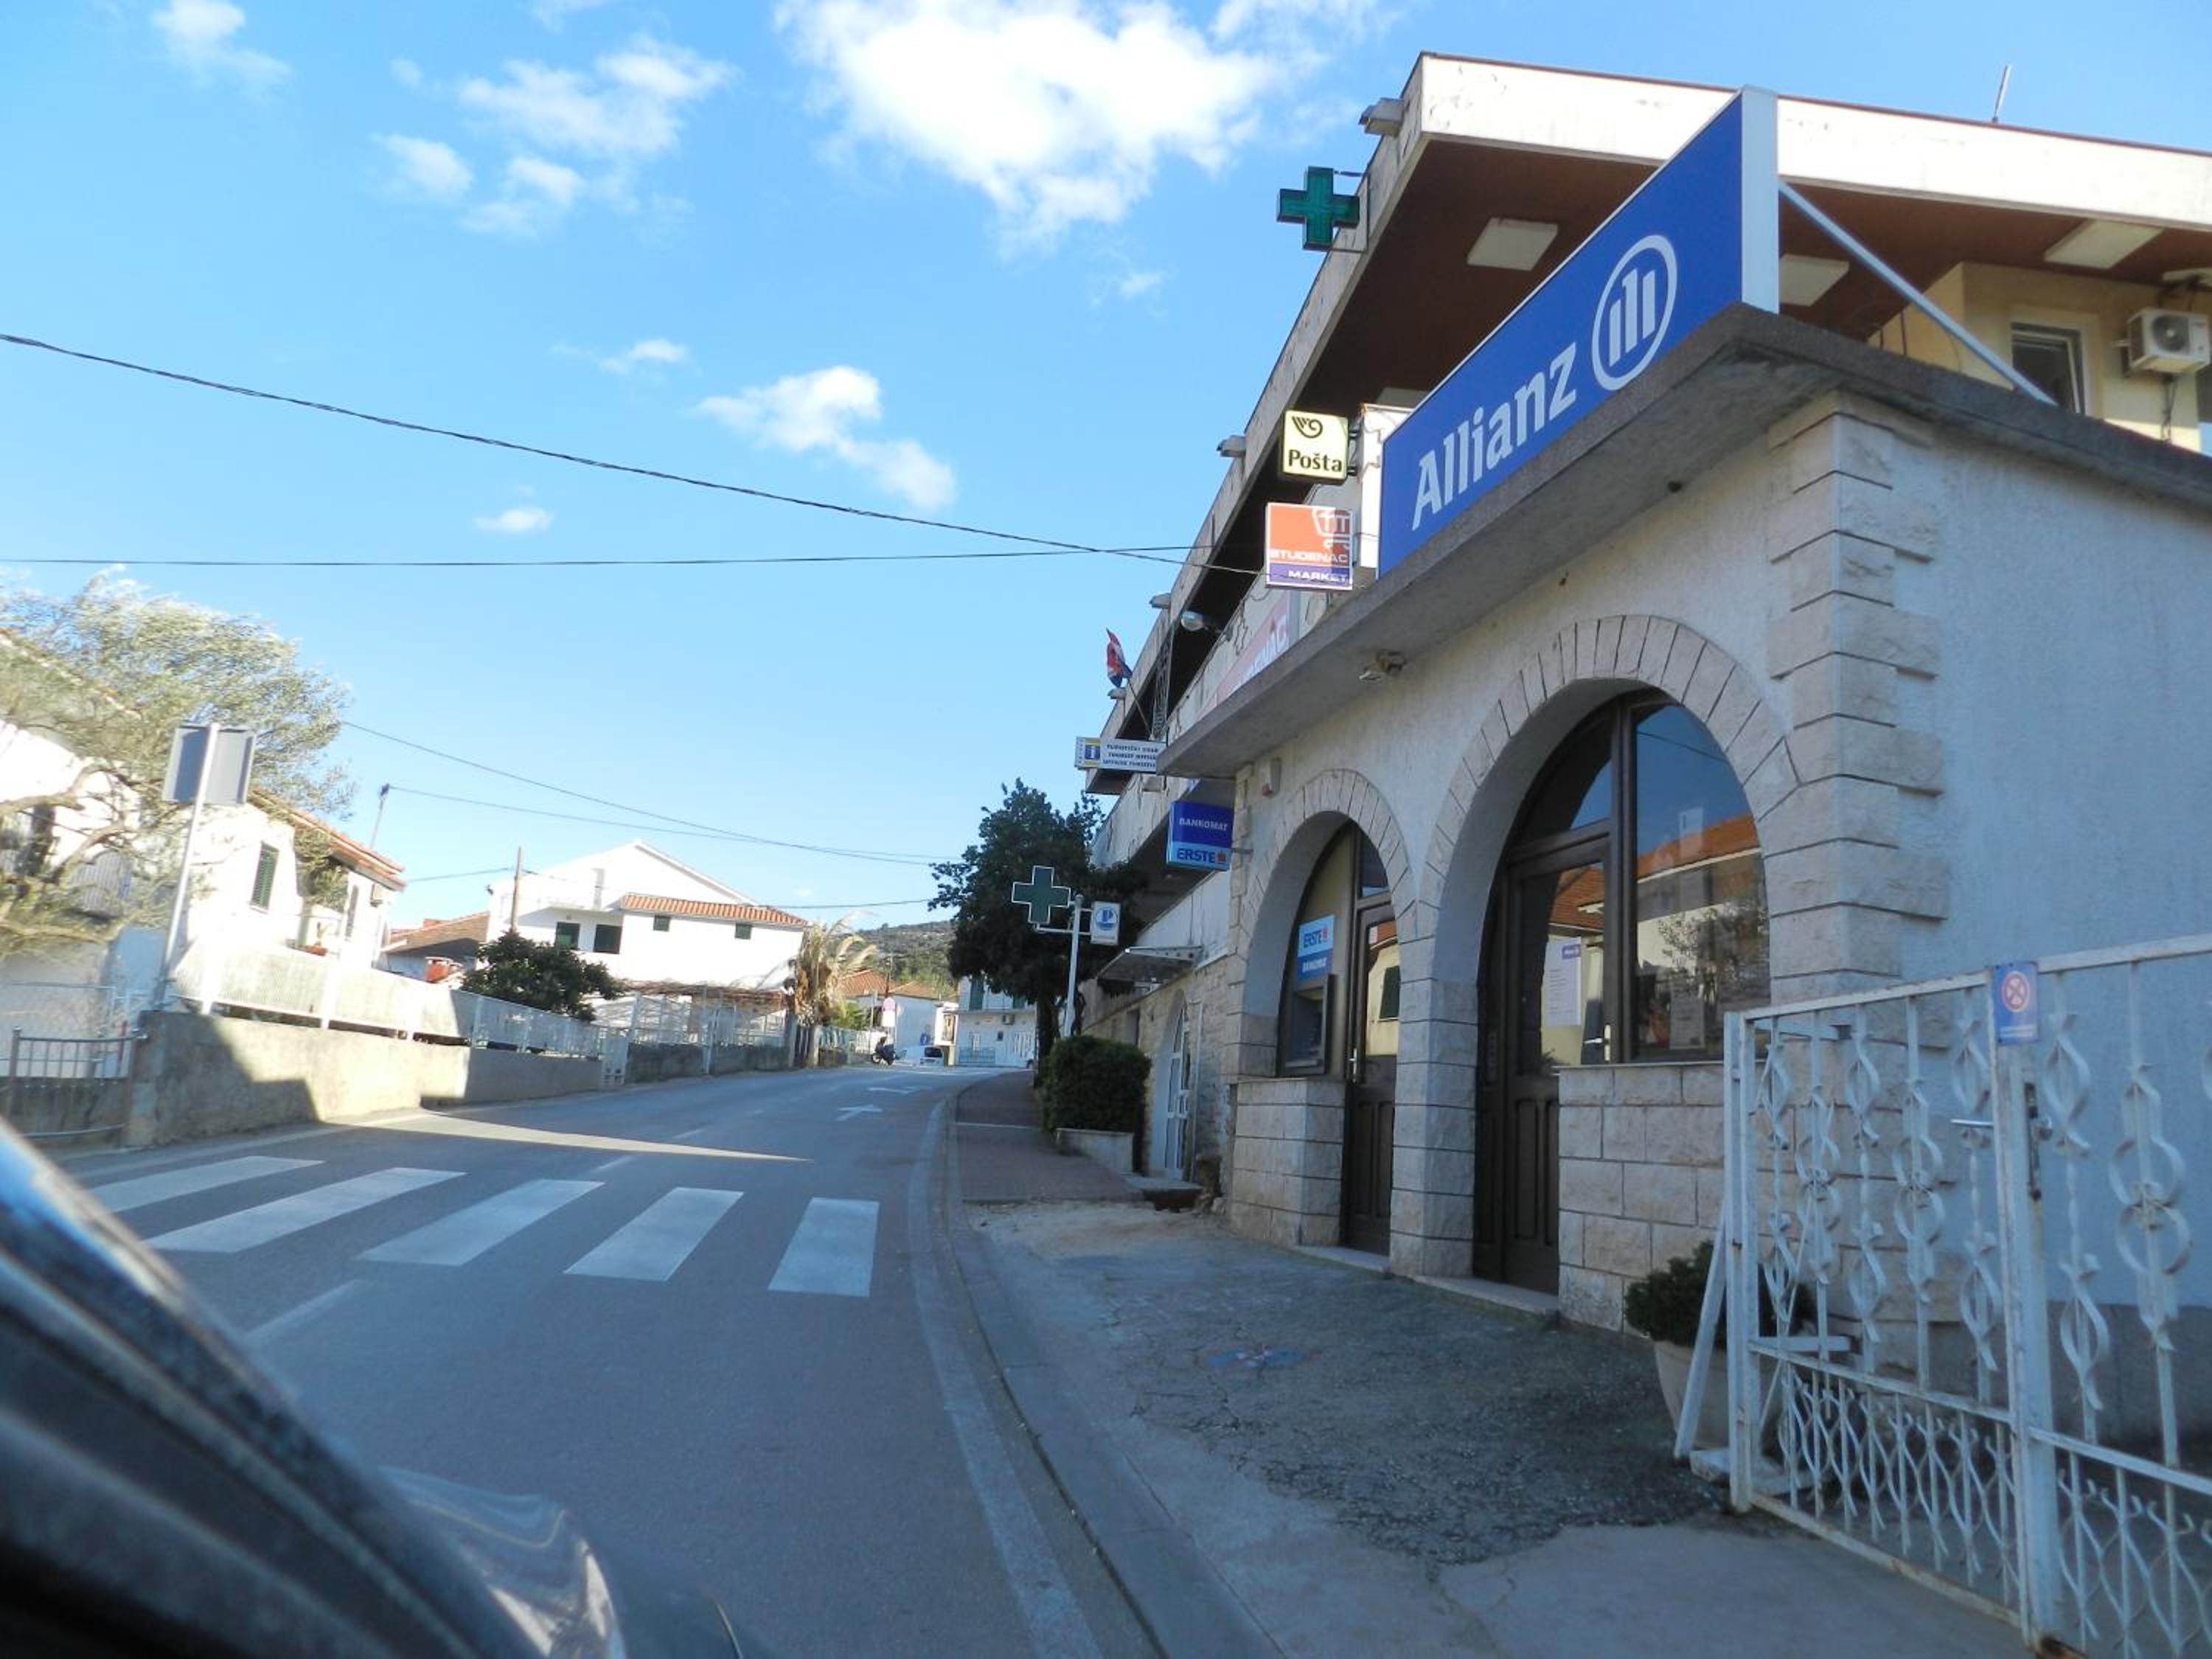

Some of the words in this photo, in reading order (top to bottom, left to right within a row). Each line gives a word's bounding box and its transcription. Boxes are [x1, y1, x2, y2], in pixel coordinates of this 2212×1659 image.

[1411, 341, 1577, 532] Allianz
[1287, 448, 1343, 473] Pošta
[1288, 569, 1347, 582] MARKET
[1179, 817, 1228, 832] BANKOMAT
[1177, 847, 1216, 863] ERSTE
[1303, 928, 1322, 949] ERSTE
